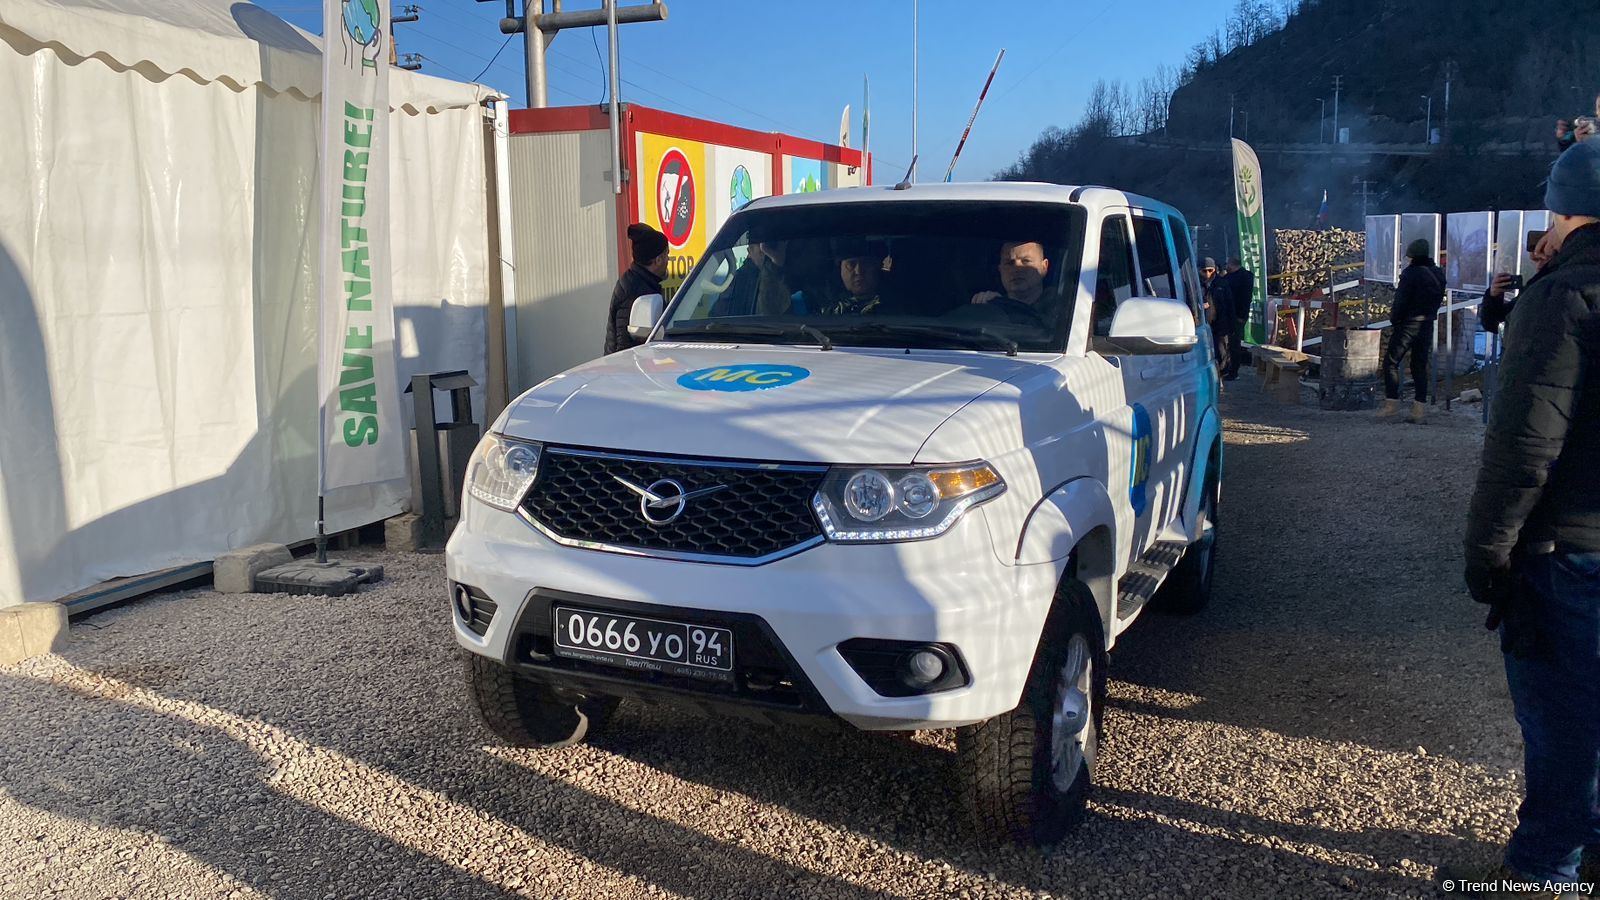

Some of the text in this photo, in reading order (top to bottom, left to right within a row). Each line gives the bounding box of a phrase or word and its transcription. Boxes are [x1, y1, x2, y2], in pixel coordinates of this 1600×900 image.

[339, 100, 379, 448] SAVE NATURE!
[666, 255, 695, 280] TOP
[568, 613, 640, 653] 0666
[691, 629, 722, 657] 94
[695, 654, 718, 666] RUS
